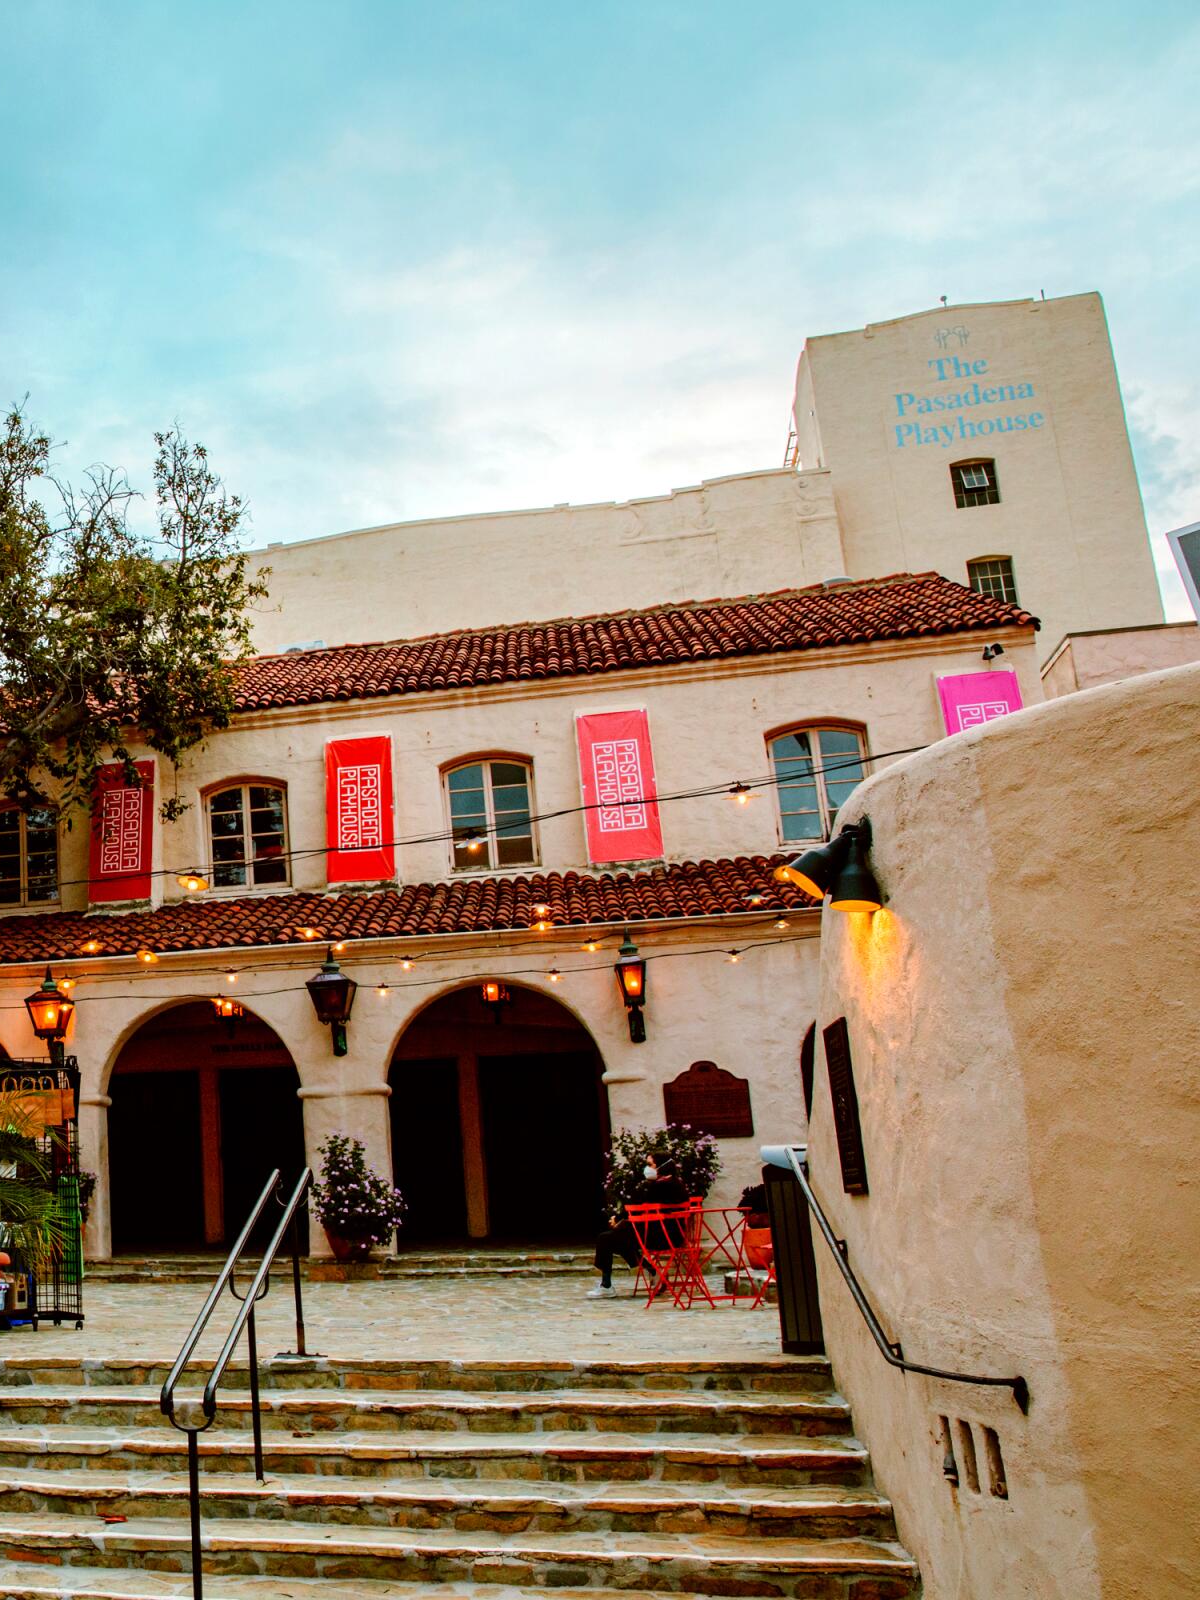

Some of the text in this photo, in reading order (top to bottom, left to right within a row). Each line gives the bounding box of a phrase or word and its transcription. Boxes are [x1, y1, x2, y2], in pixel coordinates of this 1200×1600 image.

[894, 382, 1035, 417] Pasadena
[928, 355, 989, 381] The
[895, 411, 1045, 448] Playhouse
[340, 769, 358, 849] PLAYHOUSE
[361, 768, 379, 848] PASADENA
[595, 744, 621, 828] PLAYHOUSE
[616, 743, 642, 826] PASADENA
[123, 791, 140, 869] PASADENA
